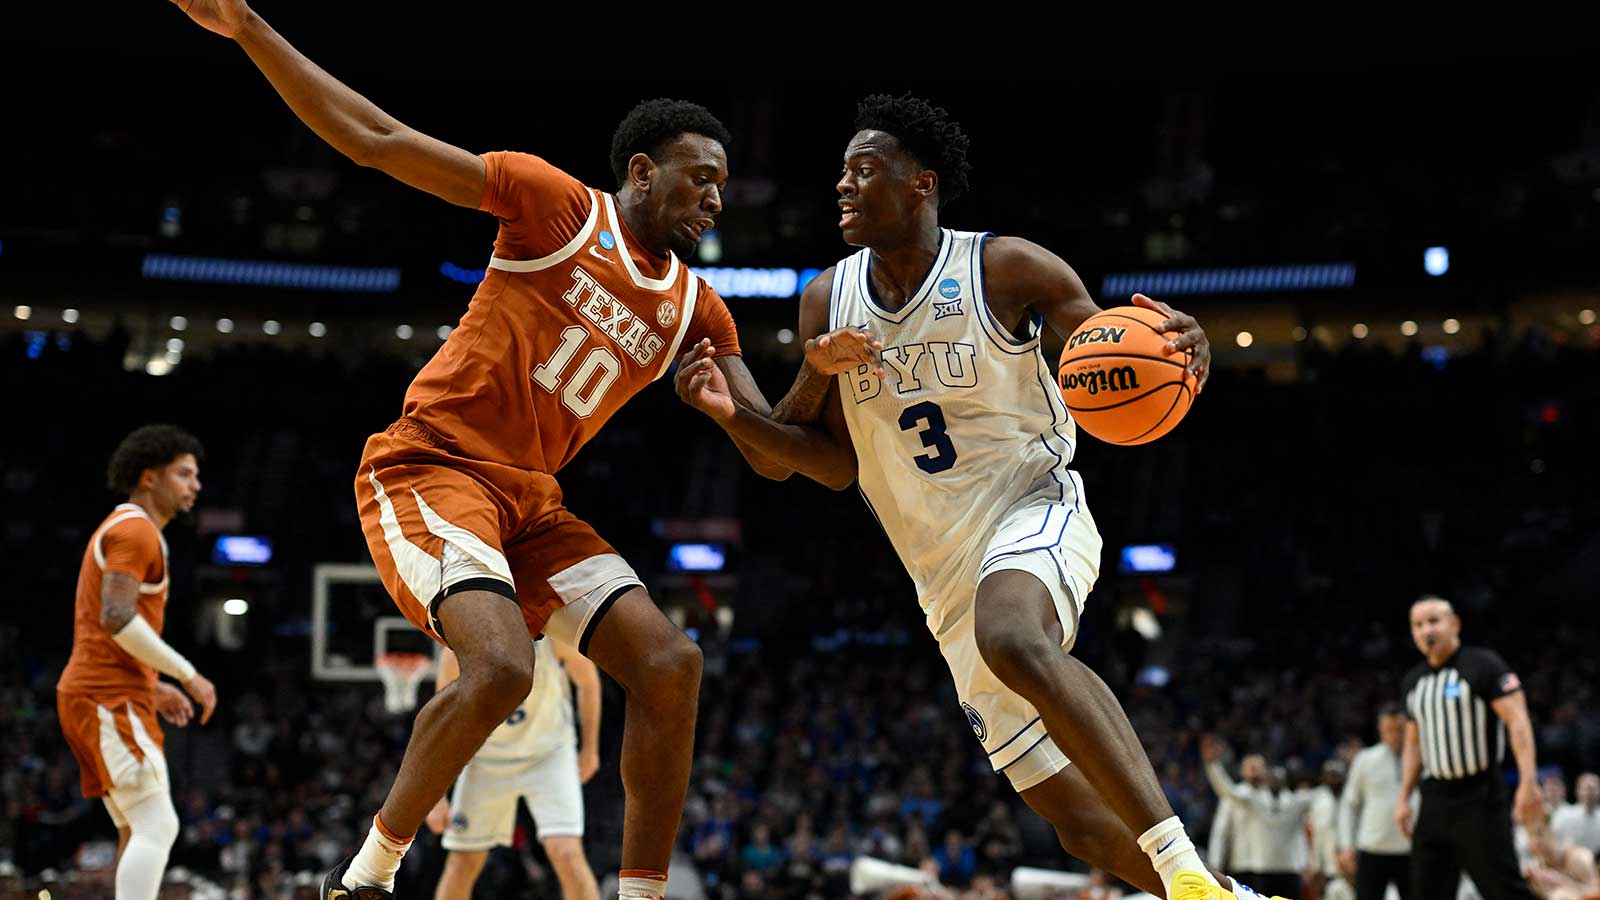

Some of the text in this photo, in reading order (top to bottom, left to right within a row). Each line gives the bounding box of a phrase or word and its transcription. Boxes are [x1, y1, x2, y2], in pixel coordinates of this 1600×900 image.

[562, 266, 665, 367] TEXAS
[1068, 327, 1127, 351] NCAA
[530, 325, 622, 420] 10
[846, 342, 978, 404] BYU
[1061, 366, 1140, 395] Wilson
[898, 401, 958, 474] 3
